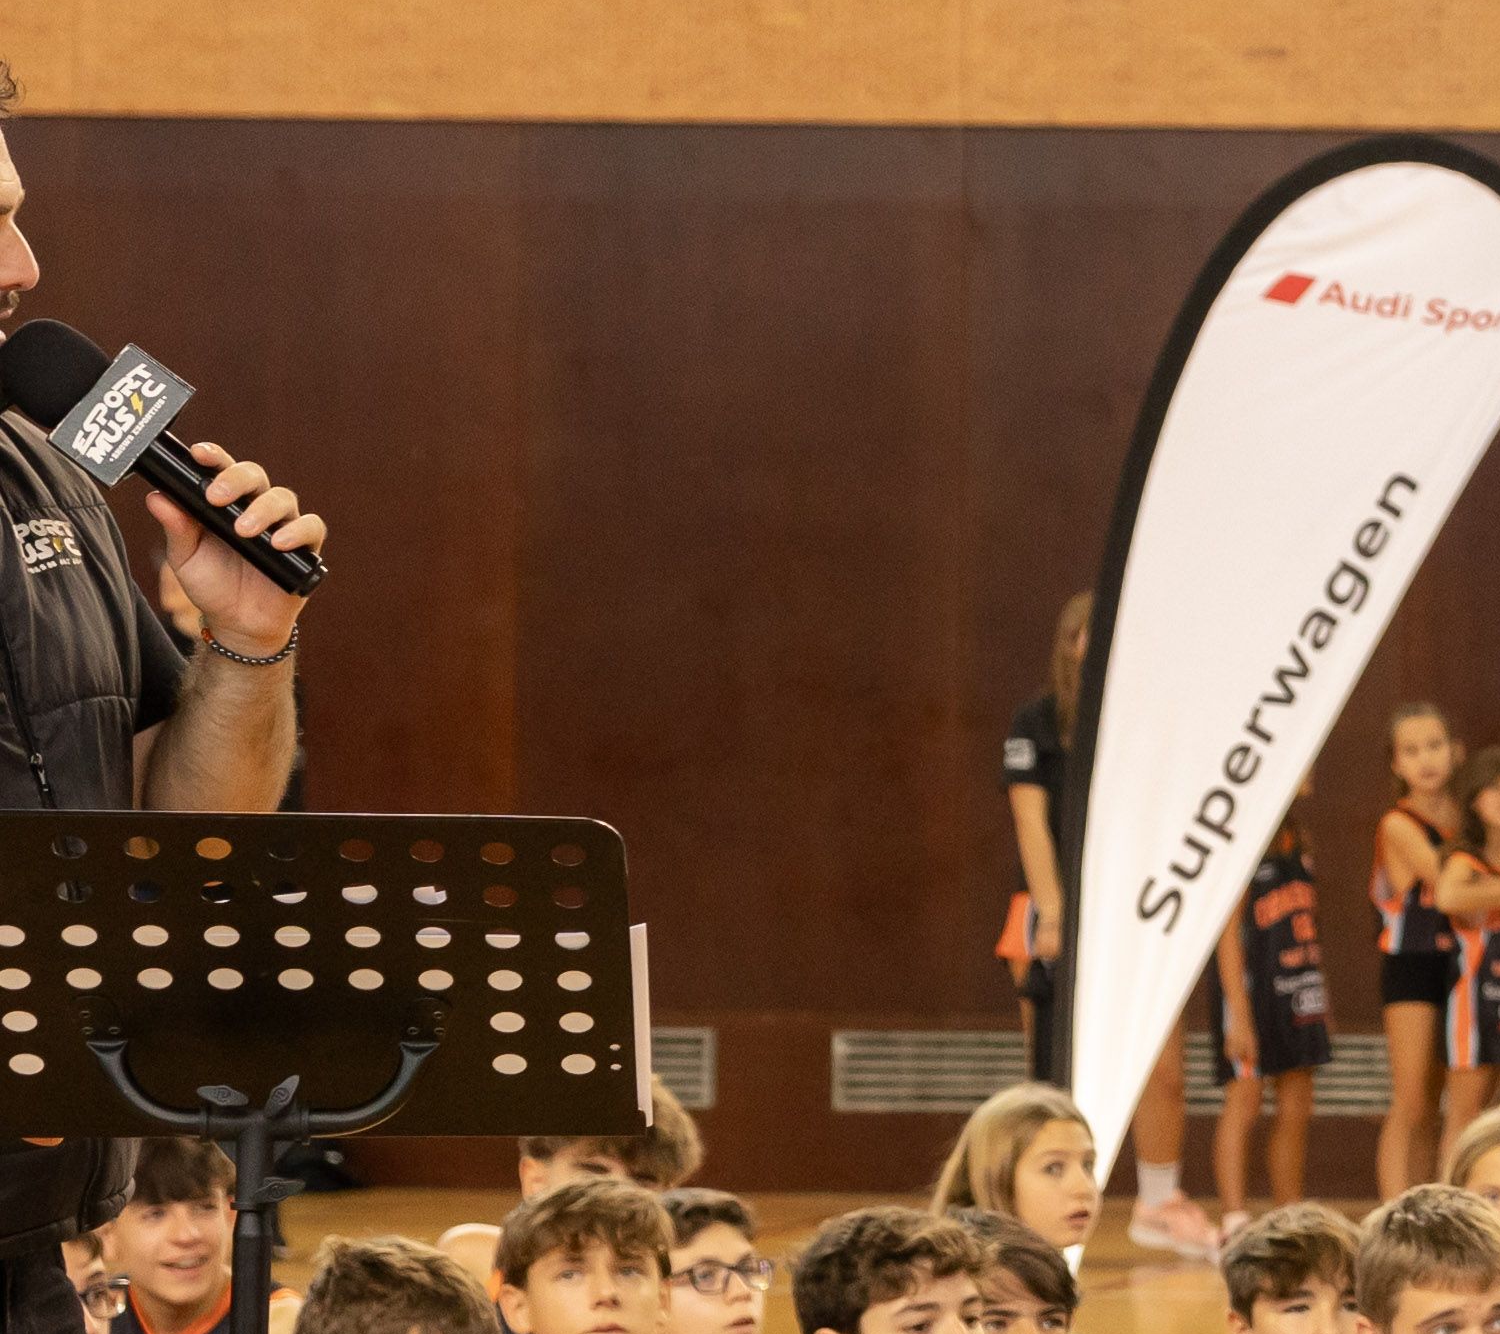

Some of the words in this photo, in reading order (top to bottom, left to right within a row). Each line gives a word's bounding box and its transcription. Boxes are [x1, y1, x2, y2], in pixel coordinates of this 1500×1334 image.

[1319, 280, 1413, 321] Audi
[72, 363, 152, 455] ESPORT
[12, 519, 74, 544] PORT
[1136, 470, 1419, 935] Superwagen
